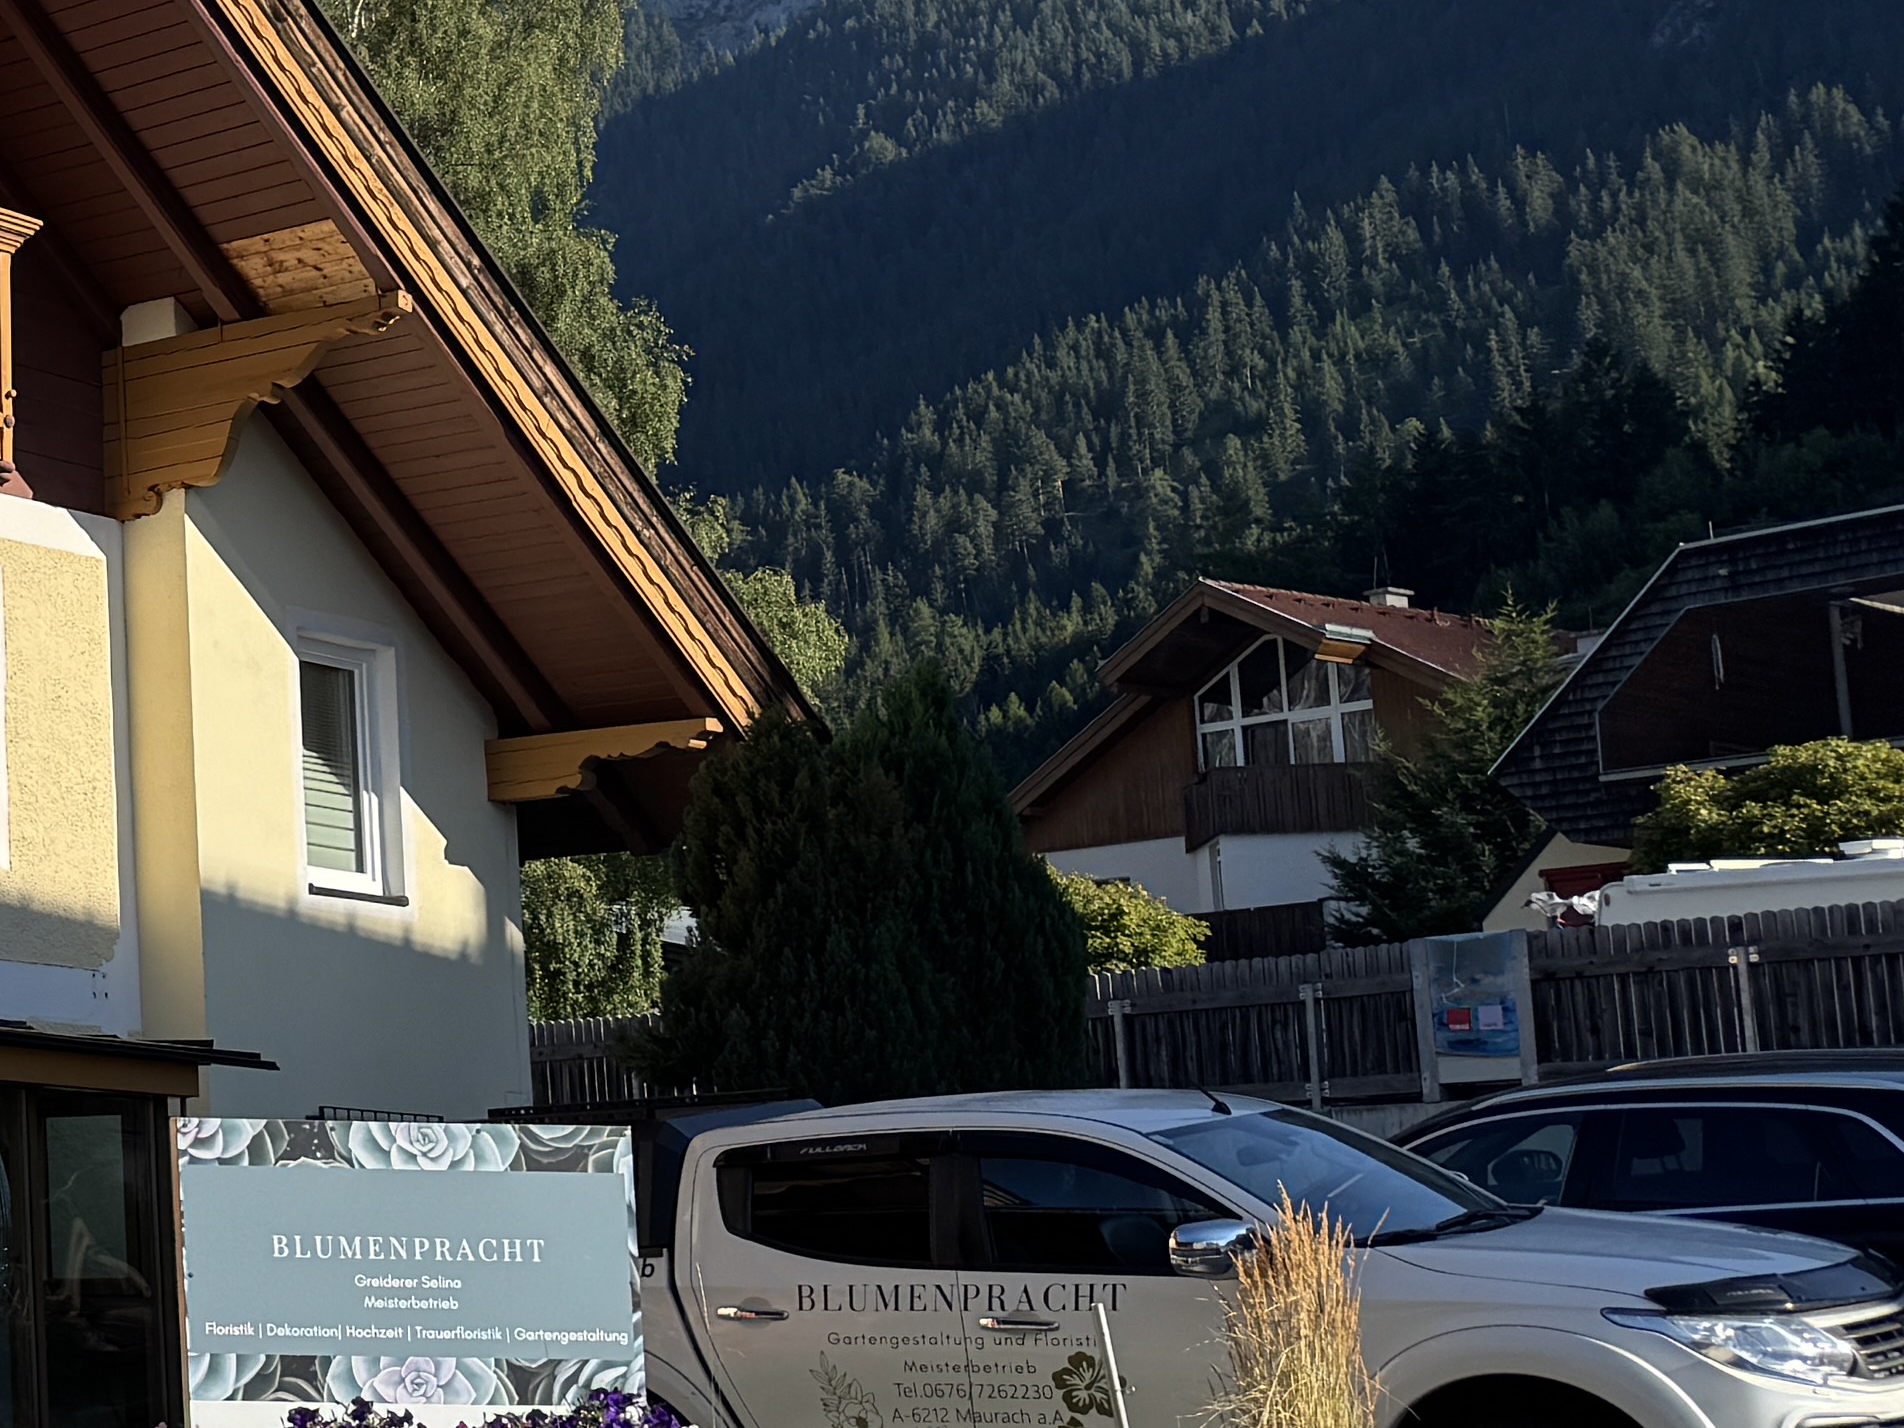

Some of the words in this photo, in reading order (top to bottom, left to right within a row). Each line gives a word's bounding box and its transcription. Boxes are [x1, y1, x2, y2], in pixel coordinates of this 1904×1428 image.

[272, 1234, 545, 1263] BLUMENPRACHT
[354, 1274, 418, 1288] Greiderer
[421, 1275, 462, 1289] Selina
[364, 1295, 459, 1310] Meisterbetrieb
[797, 1282, 1127, 1312] BLUMENPRACHT
[205, 1322, 255, 1336] Floristik
[345, 1325, 403, 1339] Hochzeit
[415, 1325, 502, 1340] Trauerfloristik
[514, 1327, 629, 1346] Gartengestaltung
[827, 1331, 985, 1350] Gartengestaltung
[993, 1332, 1026, 1346] und
[1034, 1331, 1097, 1347] Floristi
[903, 1359, 1037, 1374] Meisterbetrieb
[892, 1407, 950, 1423] A-6212
[955, 1408, 1031, 1424] Maurach
